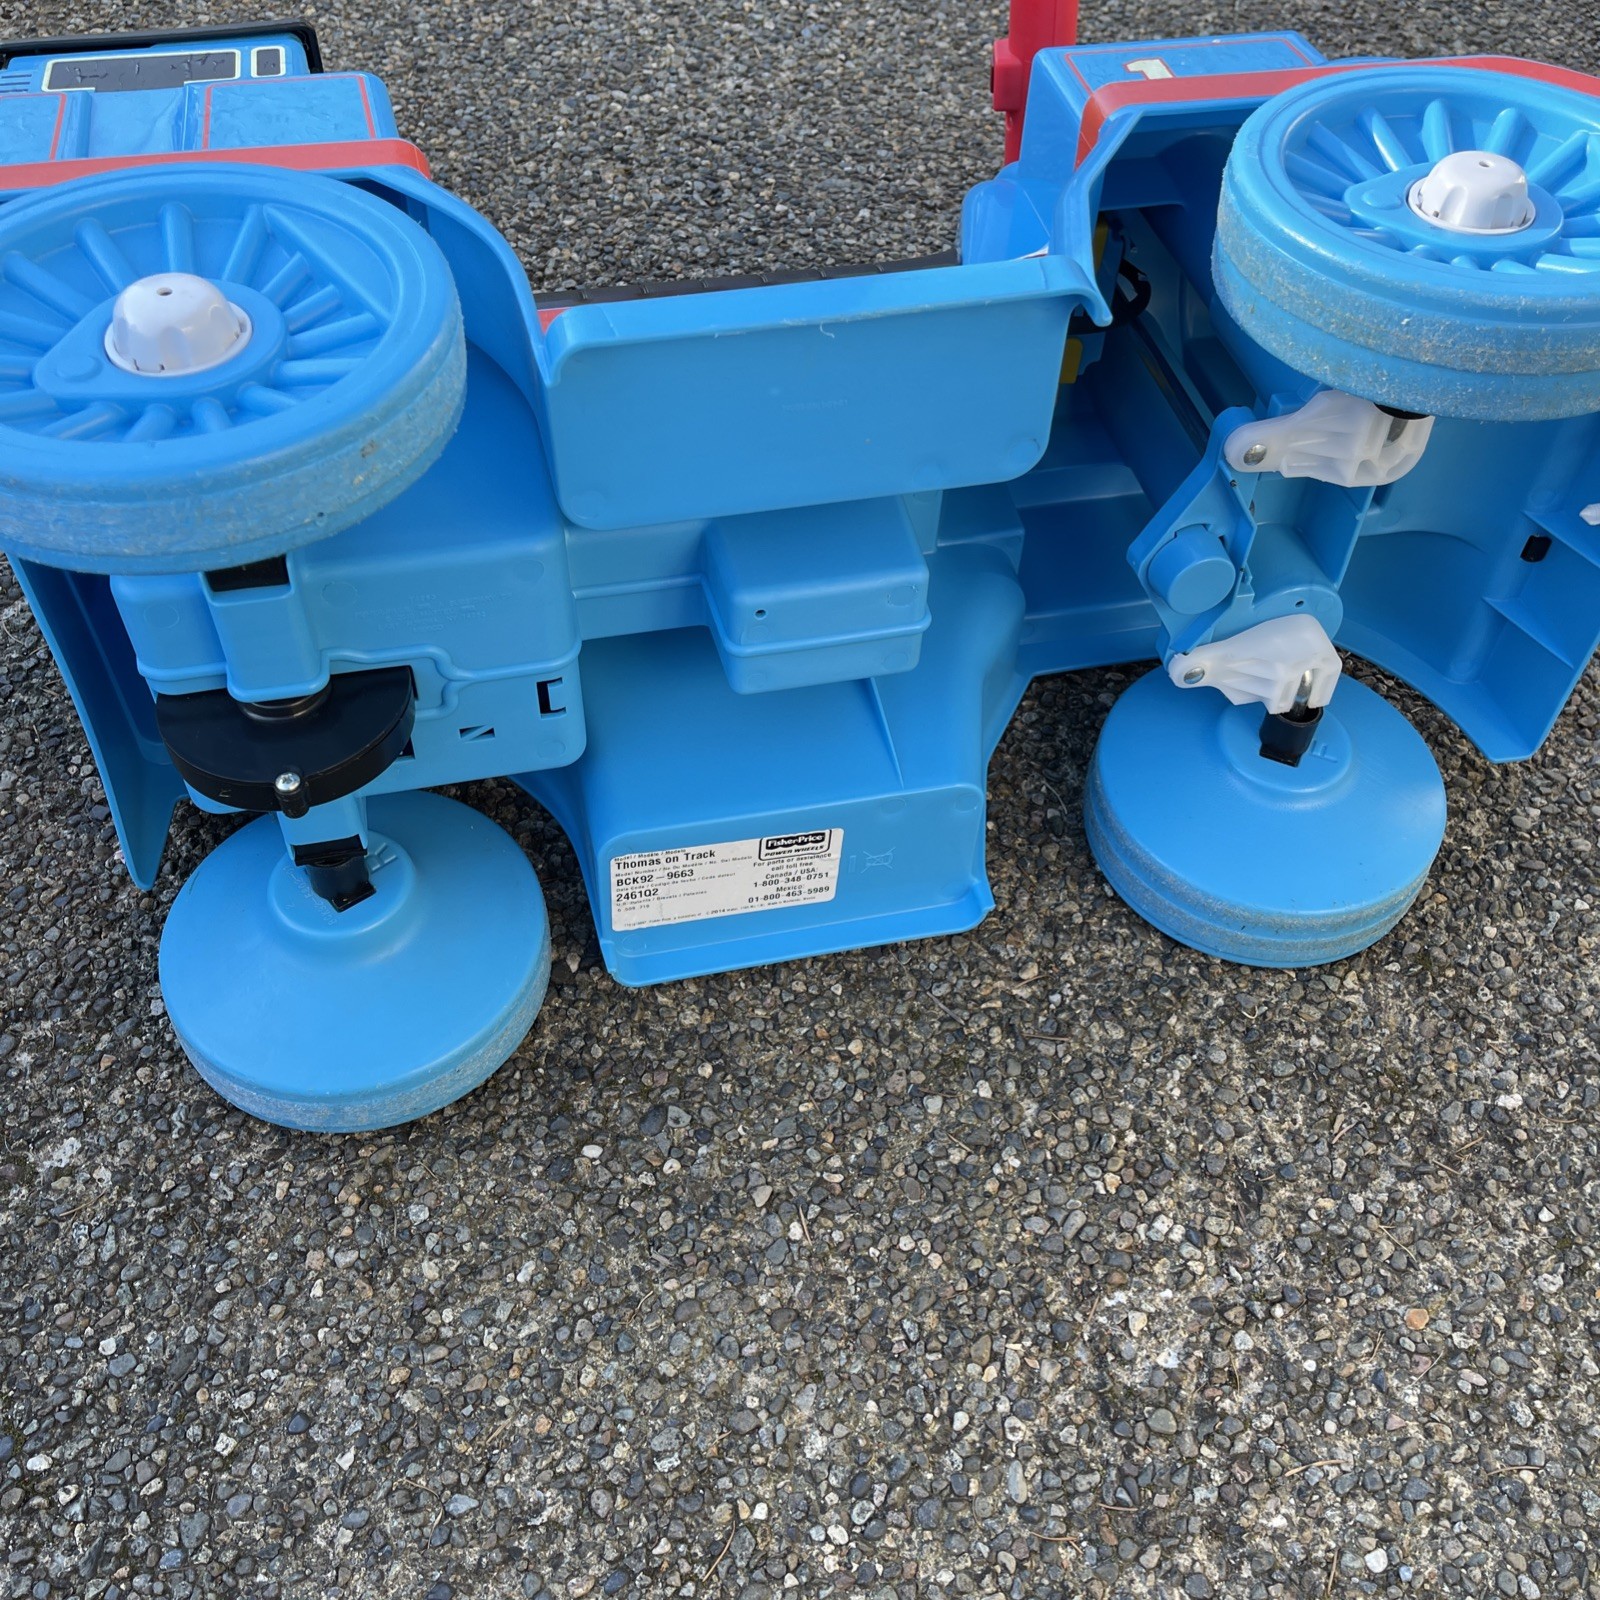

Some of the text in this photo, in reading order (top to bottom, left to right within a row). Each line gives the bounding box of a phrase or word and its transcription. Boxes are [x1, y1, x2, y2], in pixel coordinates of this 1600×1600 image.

[765, 845, 824, 857] POWER WHEELS
[615, 859, 661, 870] Thomas
[684, 850, 716, 860] Track
[616, 874, 654, 886] BCK92
[667, 869, 694, 879] 9663
[753, 872, 829, 888] 1-800-348-0751
[766, 871, 792, 880] Canada
[748, 886, 830, 903] 01-800-463-5989
